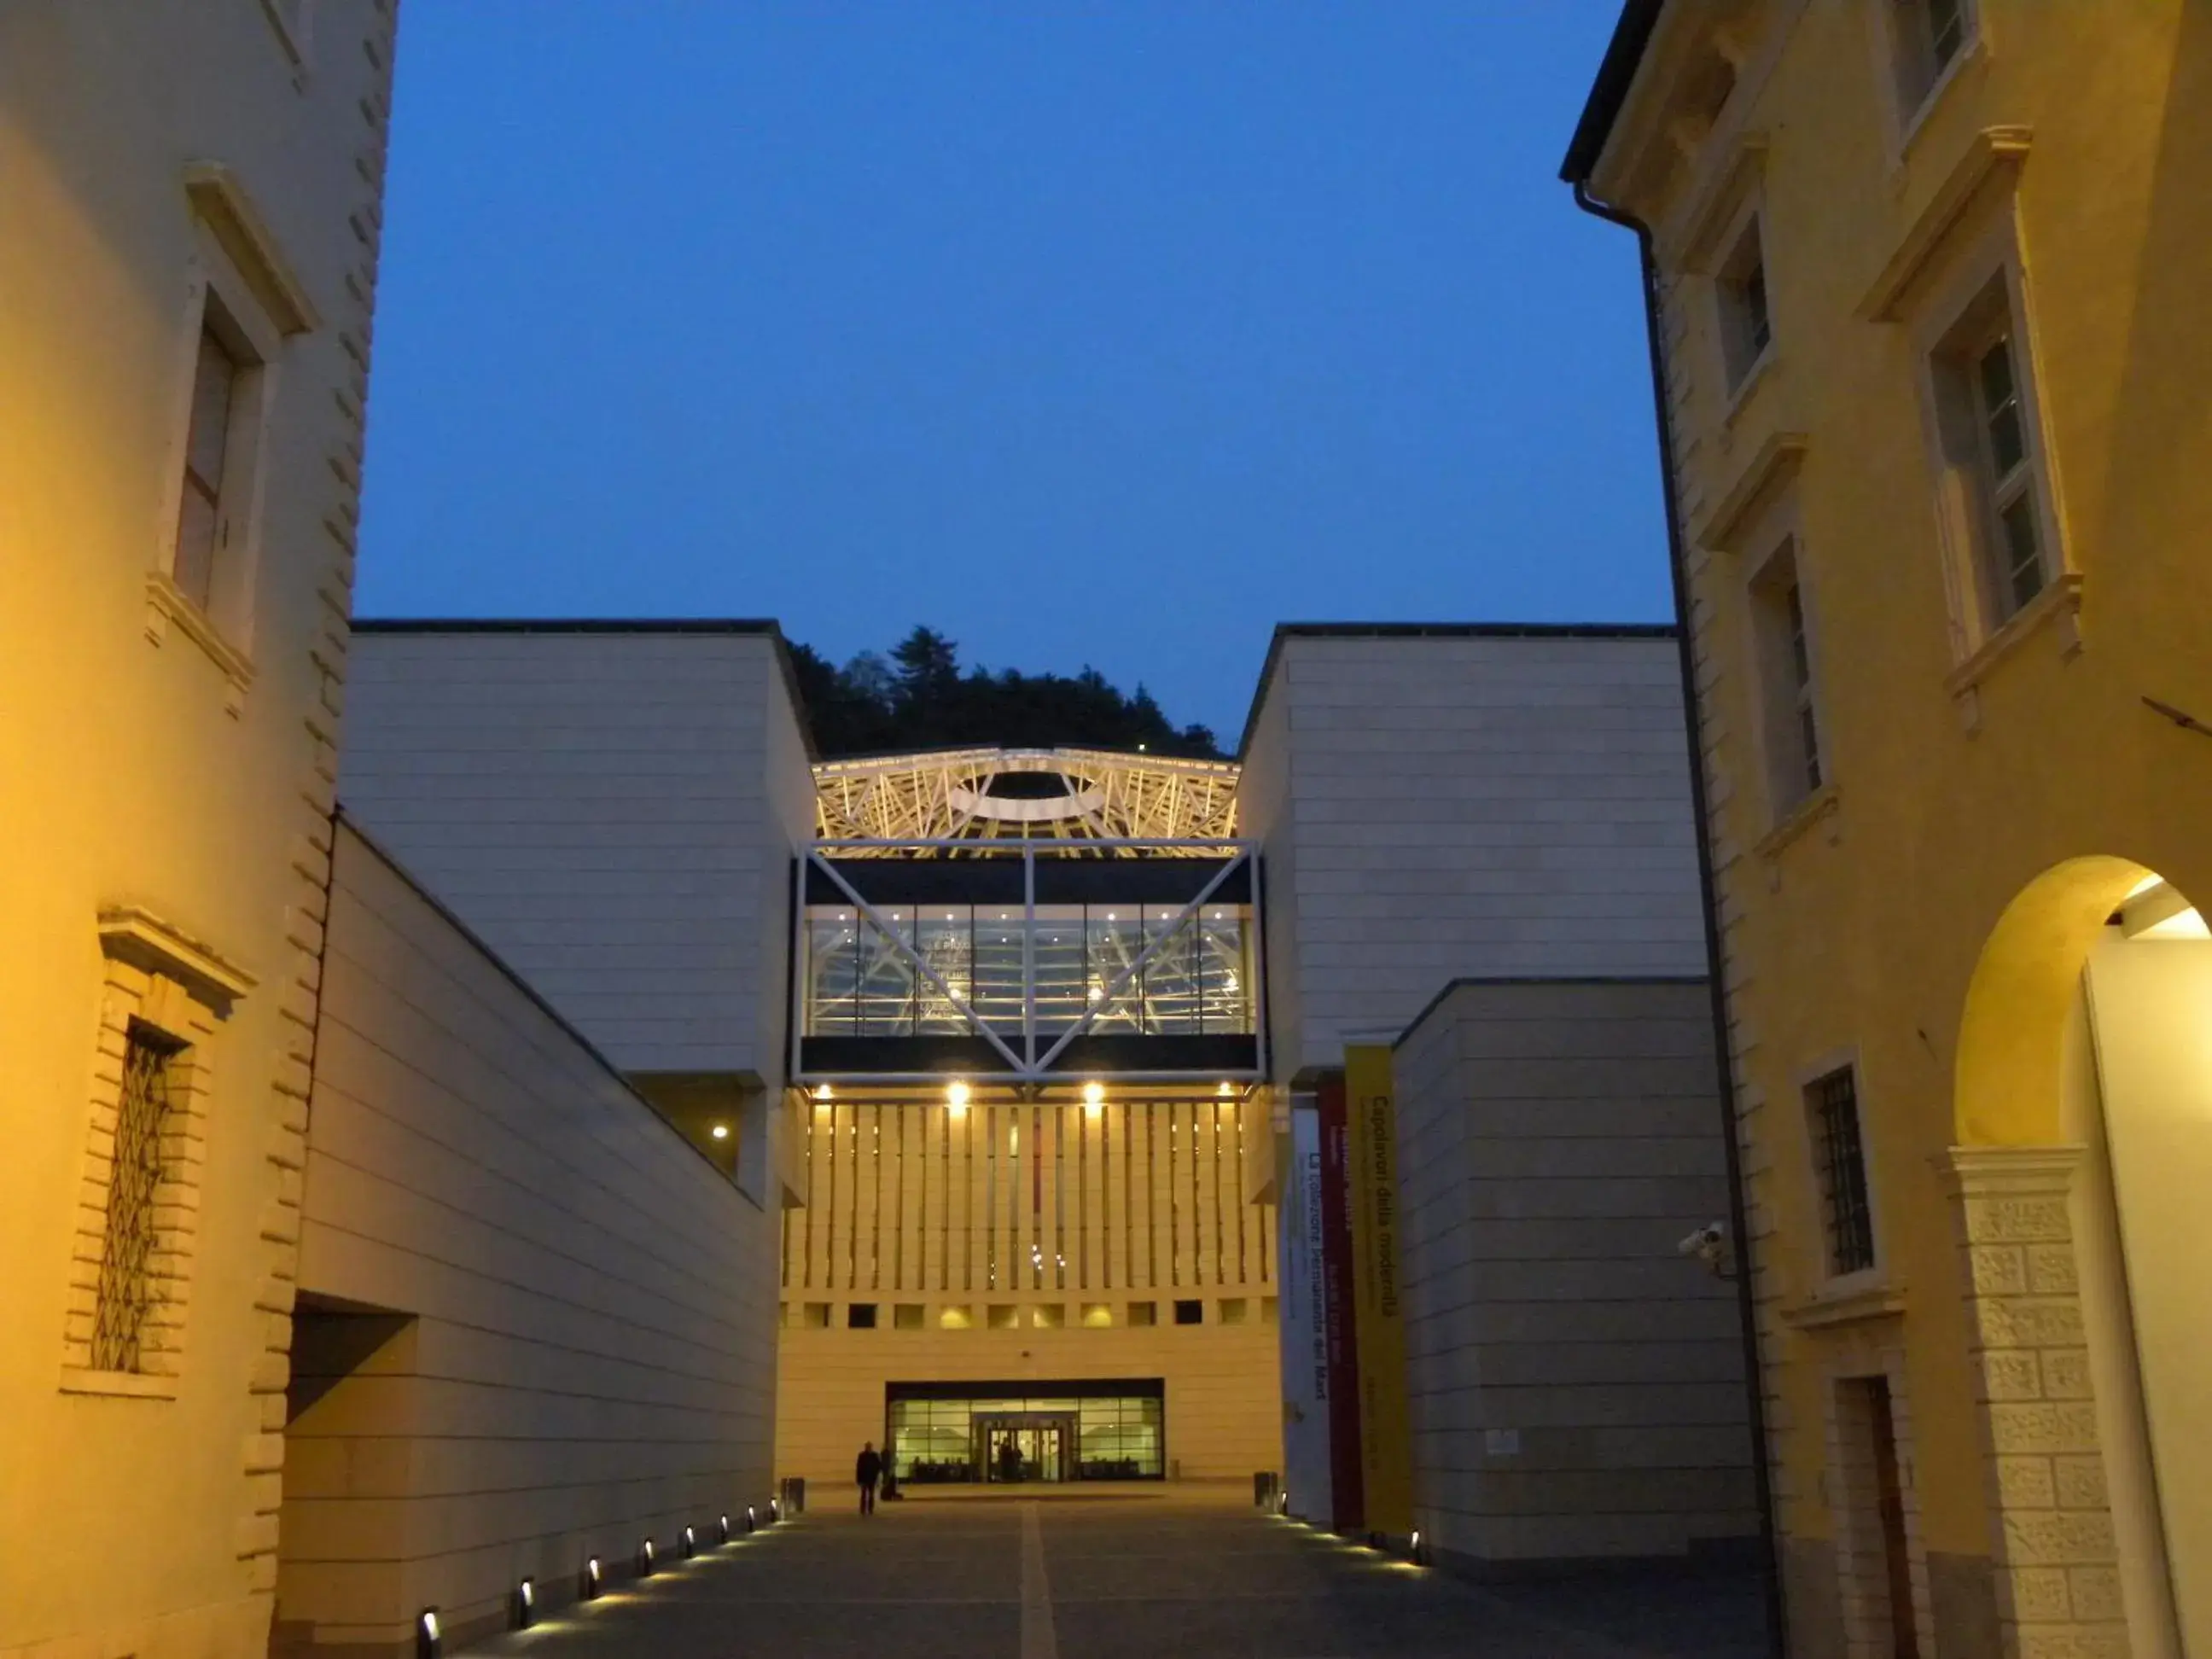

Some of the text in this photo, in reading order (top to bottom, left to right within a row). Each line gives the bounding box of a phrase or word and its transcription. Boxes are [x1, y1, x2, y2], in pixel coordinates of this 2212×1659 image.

[1371, 1096, 1392, 1180] Capolavori
[1309, 1153, 1321, 1167] La
[1377, 1187, 1394, 1226] della
[1313, 1338, 1326, 1359] del
[1314, 1366, 1328, 1400] Mart
